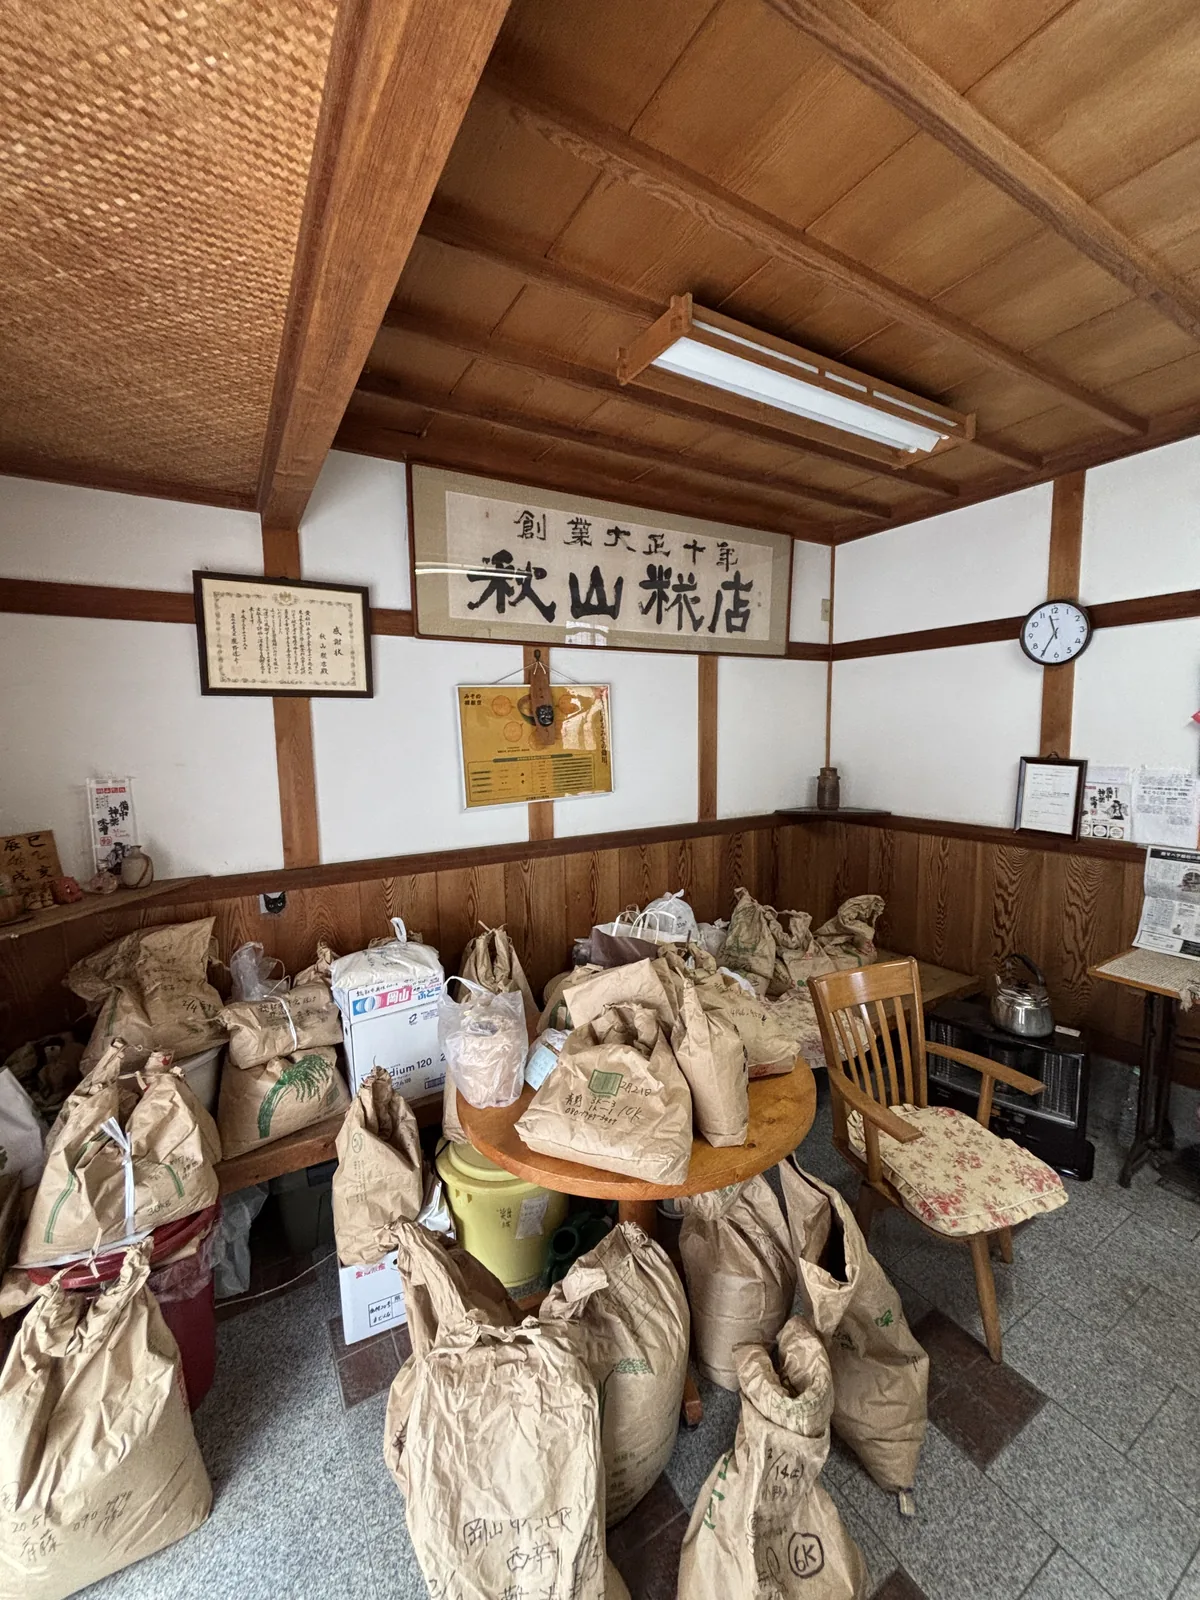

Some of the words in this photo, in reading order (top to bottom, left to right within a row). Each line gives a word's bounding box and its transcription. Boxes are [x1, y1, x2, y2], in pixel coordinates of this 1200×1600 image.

[513, 509, 738, 572] 創業大正十年
[466, 549, 754, 634] 秋山糀店
[1051, 606, 1059, 614] 12
[1066, 646, 1072, 654] 5
[386, 988, 410, 1006] 岡山
[416, 1057, 433, 1069] 120
